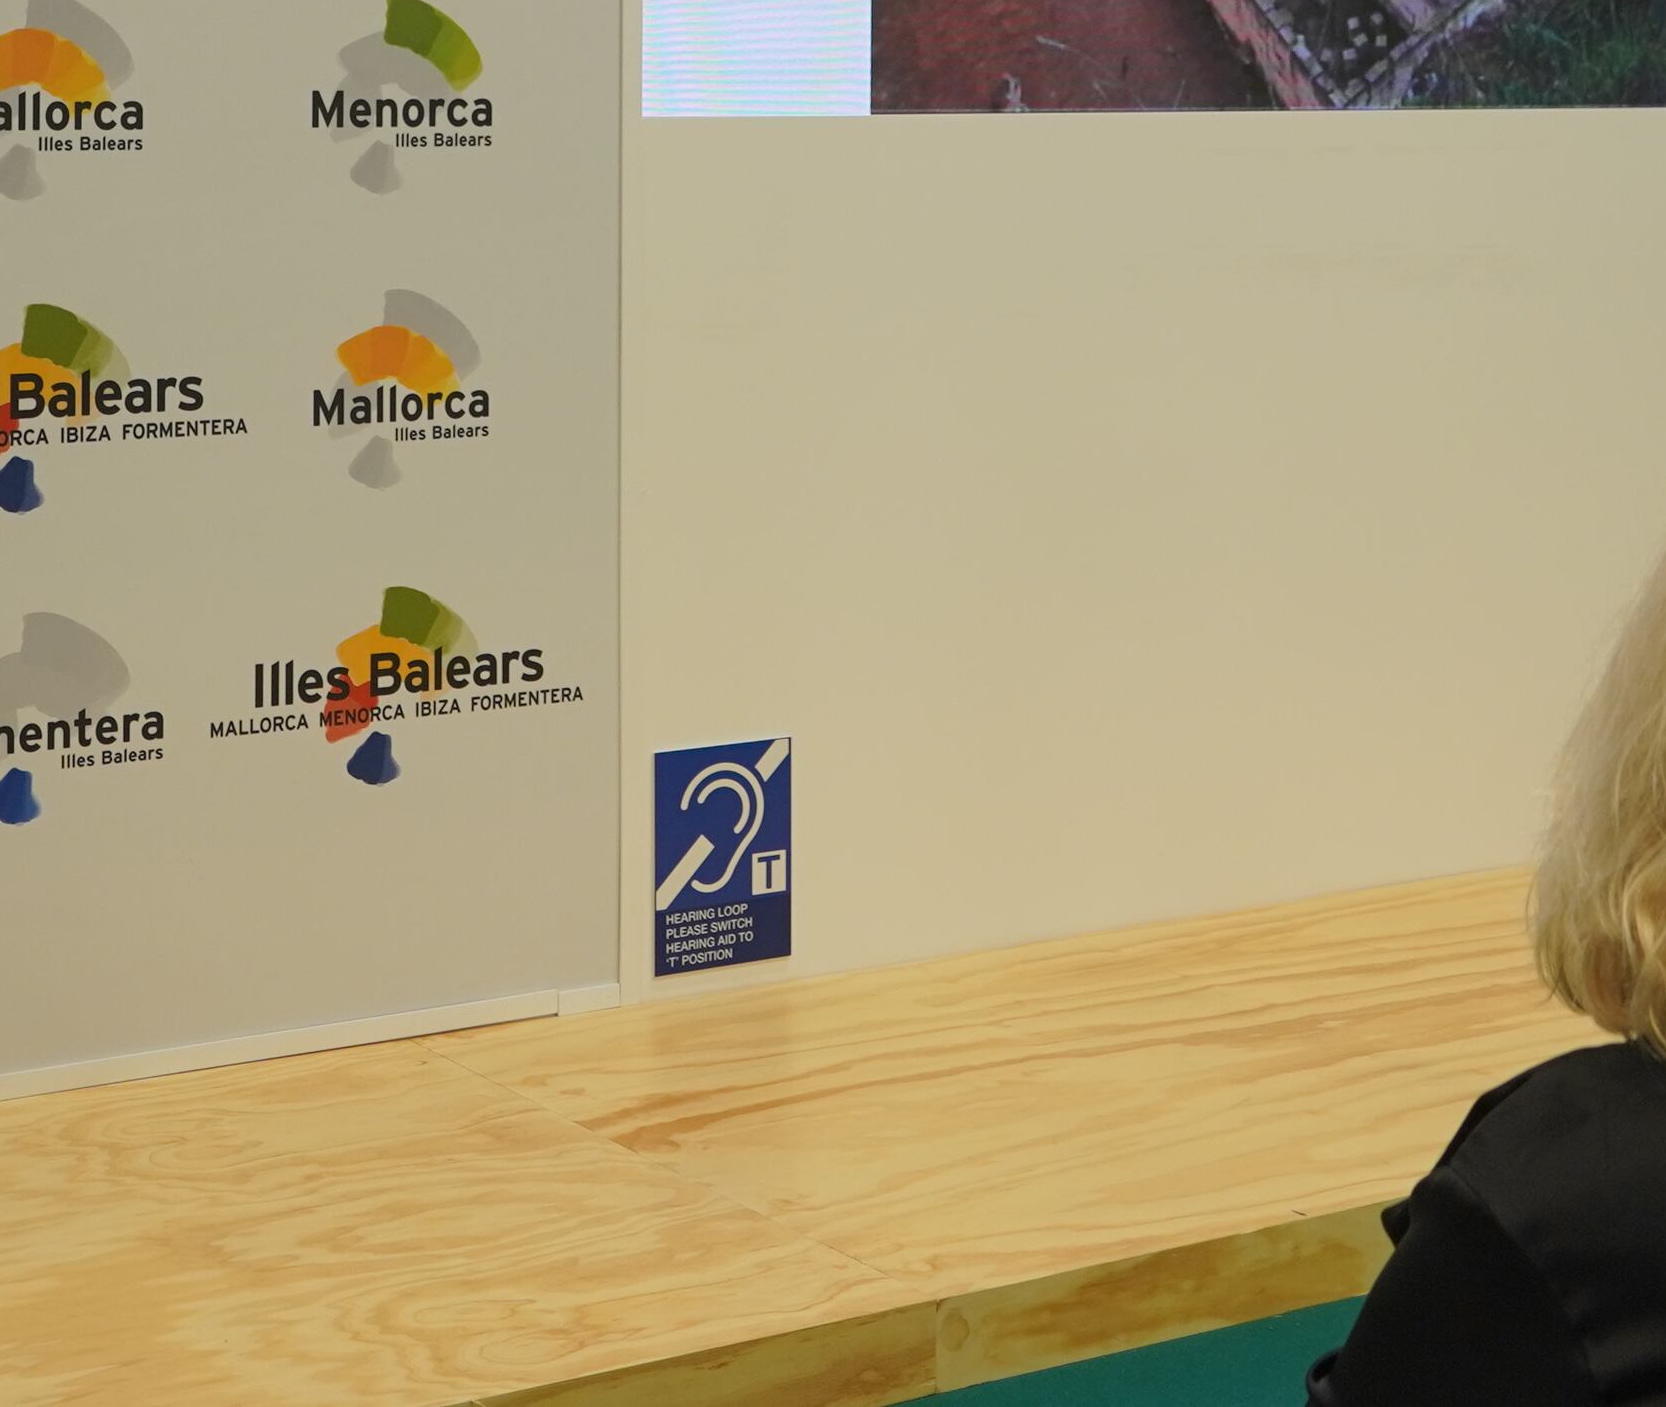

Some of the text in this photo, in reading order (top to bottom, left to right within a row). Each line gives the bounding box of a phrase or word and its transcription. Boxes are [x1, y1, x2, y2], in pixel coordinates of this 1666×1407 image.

[311, 89, 493, 129] Menorca
[38, 135, 143, 152] Illes Balears
[395, 132, 493, 148] Illes Balears
[8, 364, 204, 421] Balears
[312, 384, 490, 427] Mallorca
[60, 424, 112, 444] IBIZA
[122, 417, 248, 441] FORMENTERA
[395, 424, 490, 442] Illes Balears
[254, 646, 544, 709] Illes Balears
[210, 686, 584, 739] MALLORCA MENORCA IBIZA FORMENTERA
[61, 747, 164, 770] Illes Balears
[758, 855, 780, 889] T
[666, 903, 748, 925] HEARING LOOP
[666, 917, 753, 939] PLEASE SWITCH
[666, 930, 753, 954] HEARING AID TO
[682, 949, 733, 965] POSITION
